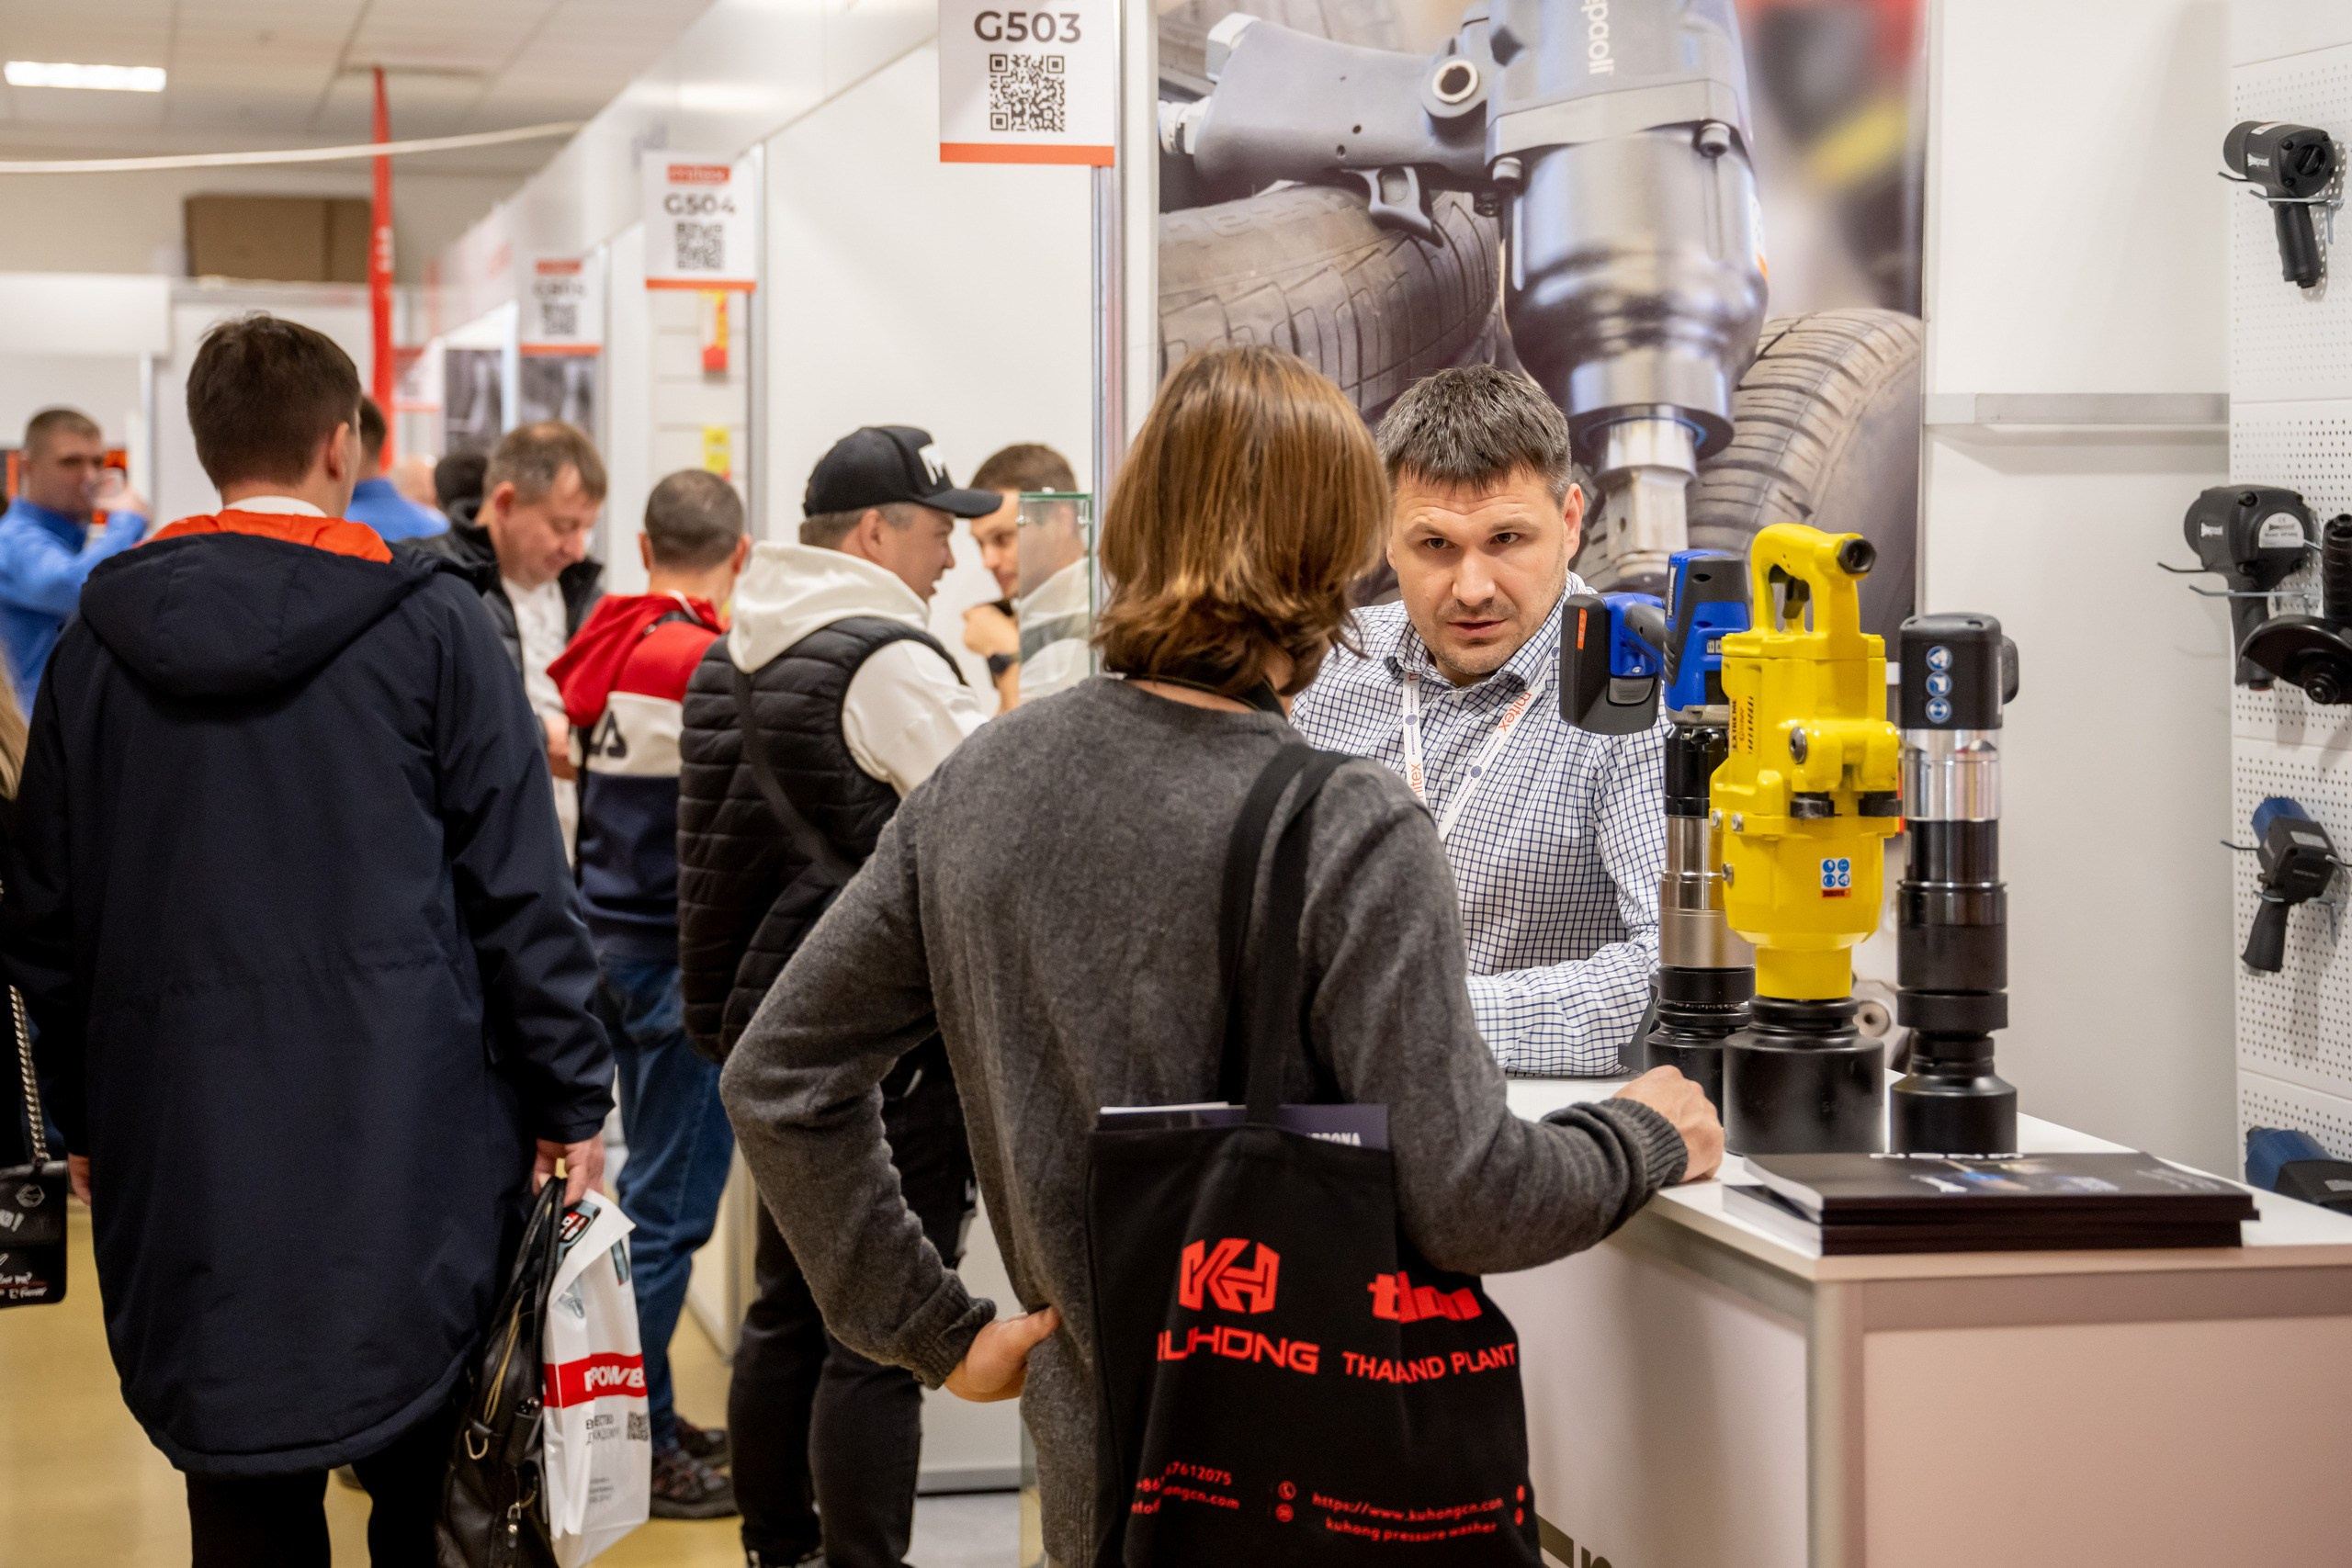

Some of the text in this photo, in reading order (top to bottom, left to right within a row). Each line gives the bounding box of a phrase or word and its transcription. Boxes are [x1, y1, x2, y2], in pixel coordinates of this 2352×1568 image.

[974, 10, 1081, 43] G503
[663, 192, 736, 216] G504
[1498, 692, 1533, 733] mitex
[1449, 1342, 1516, 1375] PLANT
[1326, 1517, 1497, 1542] kuhong pressure washer
